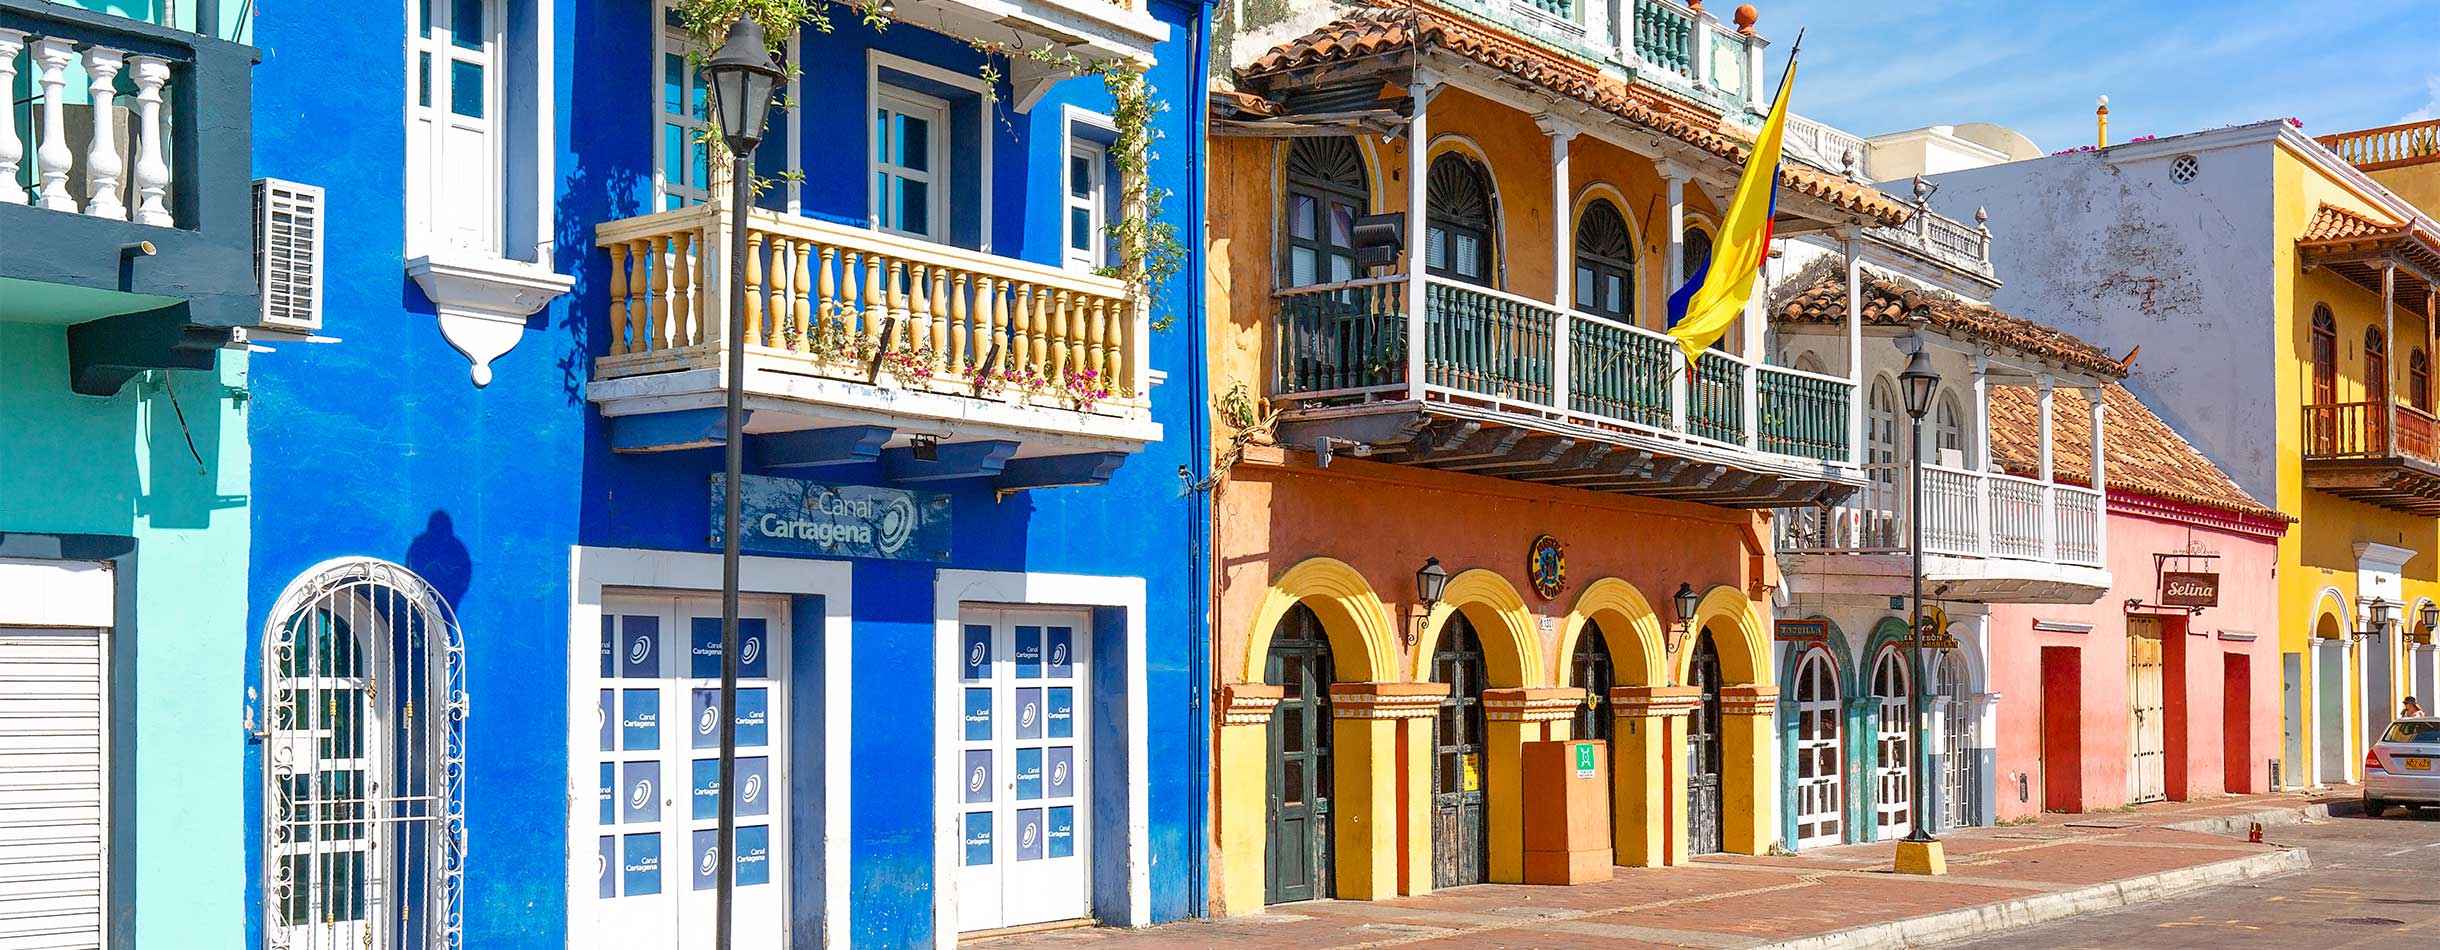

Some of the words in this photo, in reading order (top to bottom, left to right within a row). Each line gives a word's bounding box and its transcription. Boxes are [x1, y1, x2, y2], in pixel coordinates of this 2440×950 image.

[817, 491, 873, 519] Canal
[759, 513, 871, 547] Cartagena
[2167, 581, 2214, 598] Selina
[1026, 645, 1039, 653] Canal
[1015, 651, 1039, 659] Cartagena
[749, 710, 764, 718] Canal
[623, 720, 656, 728] Cartagena
[735, 717, 764, 725] Cartagena
[750, 847, 766, 855] Canal
[641, 857, 658, 865] Canal
[736, 855, 766, 863] Cartagena
[625, 864, 658, 873] Cartagena
